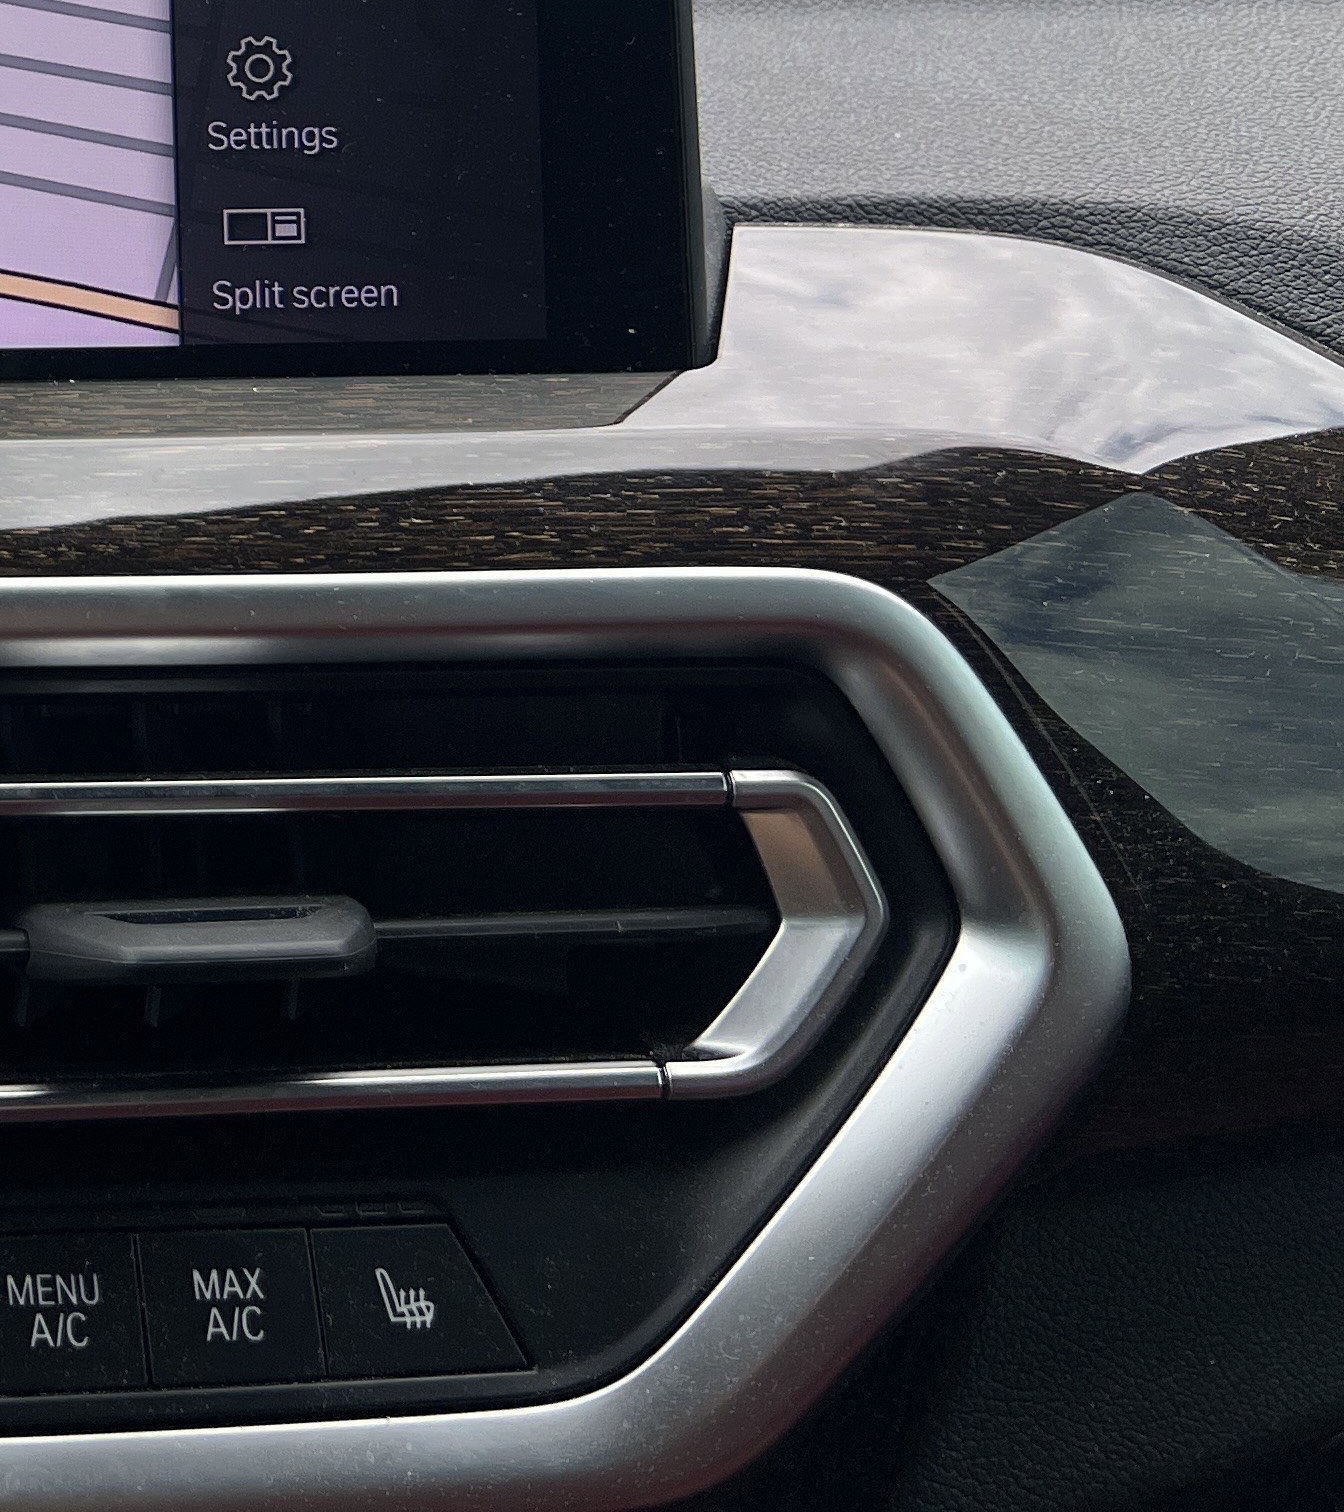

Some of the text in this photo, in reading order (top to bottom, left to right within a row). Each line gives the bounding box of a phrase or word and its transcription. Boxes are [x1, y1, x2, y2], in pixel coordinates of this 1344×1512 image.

[207, 121, 338, 155] Settings
[212, 279, 398, 315] Split screen
[6, 1273, 100, 1307] MENU
[192, 1267, 265, 1301] MAX
[30, 1311, 89, 1348] A/C
[206, 1305, 264, 1342] A/C
